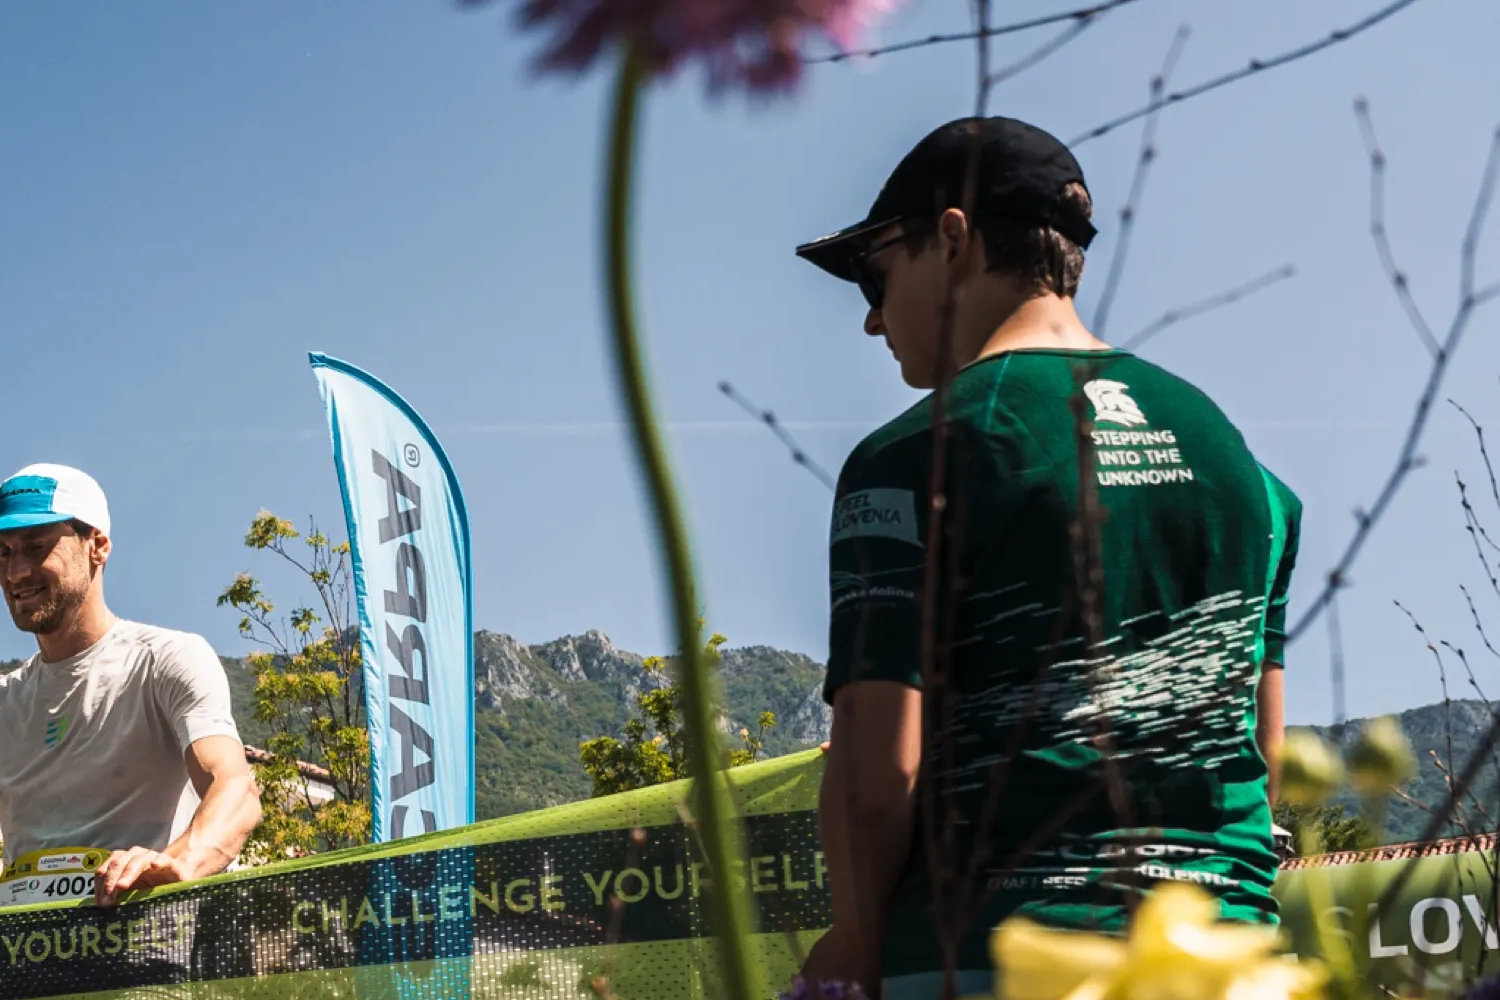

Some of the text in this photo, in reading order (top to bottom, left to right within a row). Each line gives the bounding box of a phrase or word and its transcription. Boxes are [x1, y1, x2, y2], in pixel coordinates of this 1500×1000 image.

[1091, 430, 1177, 446] STEPPING
[1097, 448, 1182, 466] INTO THE
[1097, 468, 1194, 486] UNKNOWN
[291, 875, 565, 936] CHALLENGE
[1, 913, 196, 966] YOURSELF
